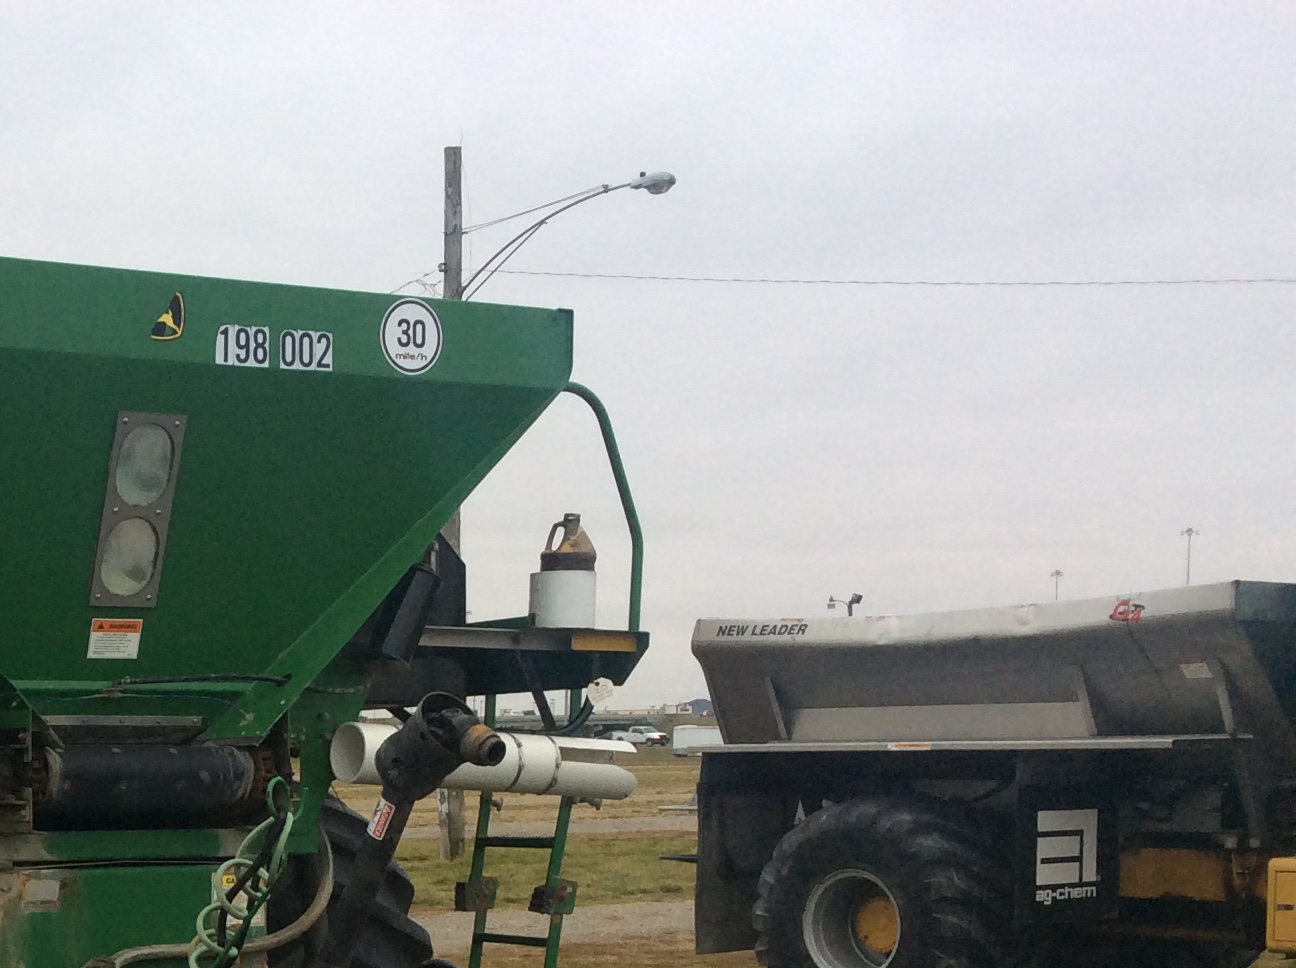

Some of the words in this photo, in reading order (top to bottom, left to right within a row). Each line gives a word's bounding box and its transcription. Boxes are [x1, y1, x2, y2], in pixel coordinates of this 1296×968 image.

[397, 318, 426, 349] 30
[219, 326, 268, 364] 198
[281, 331, 331, 369] 002
[395, 351, 428, 361] mile/h
[716, 624, 750, 637] NEW
[750, 623, 809, 636] LEADER
[1035, 886, 1097, 905] ag-chem
